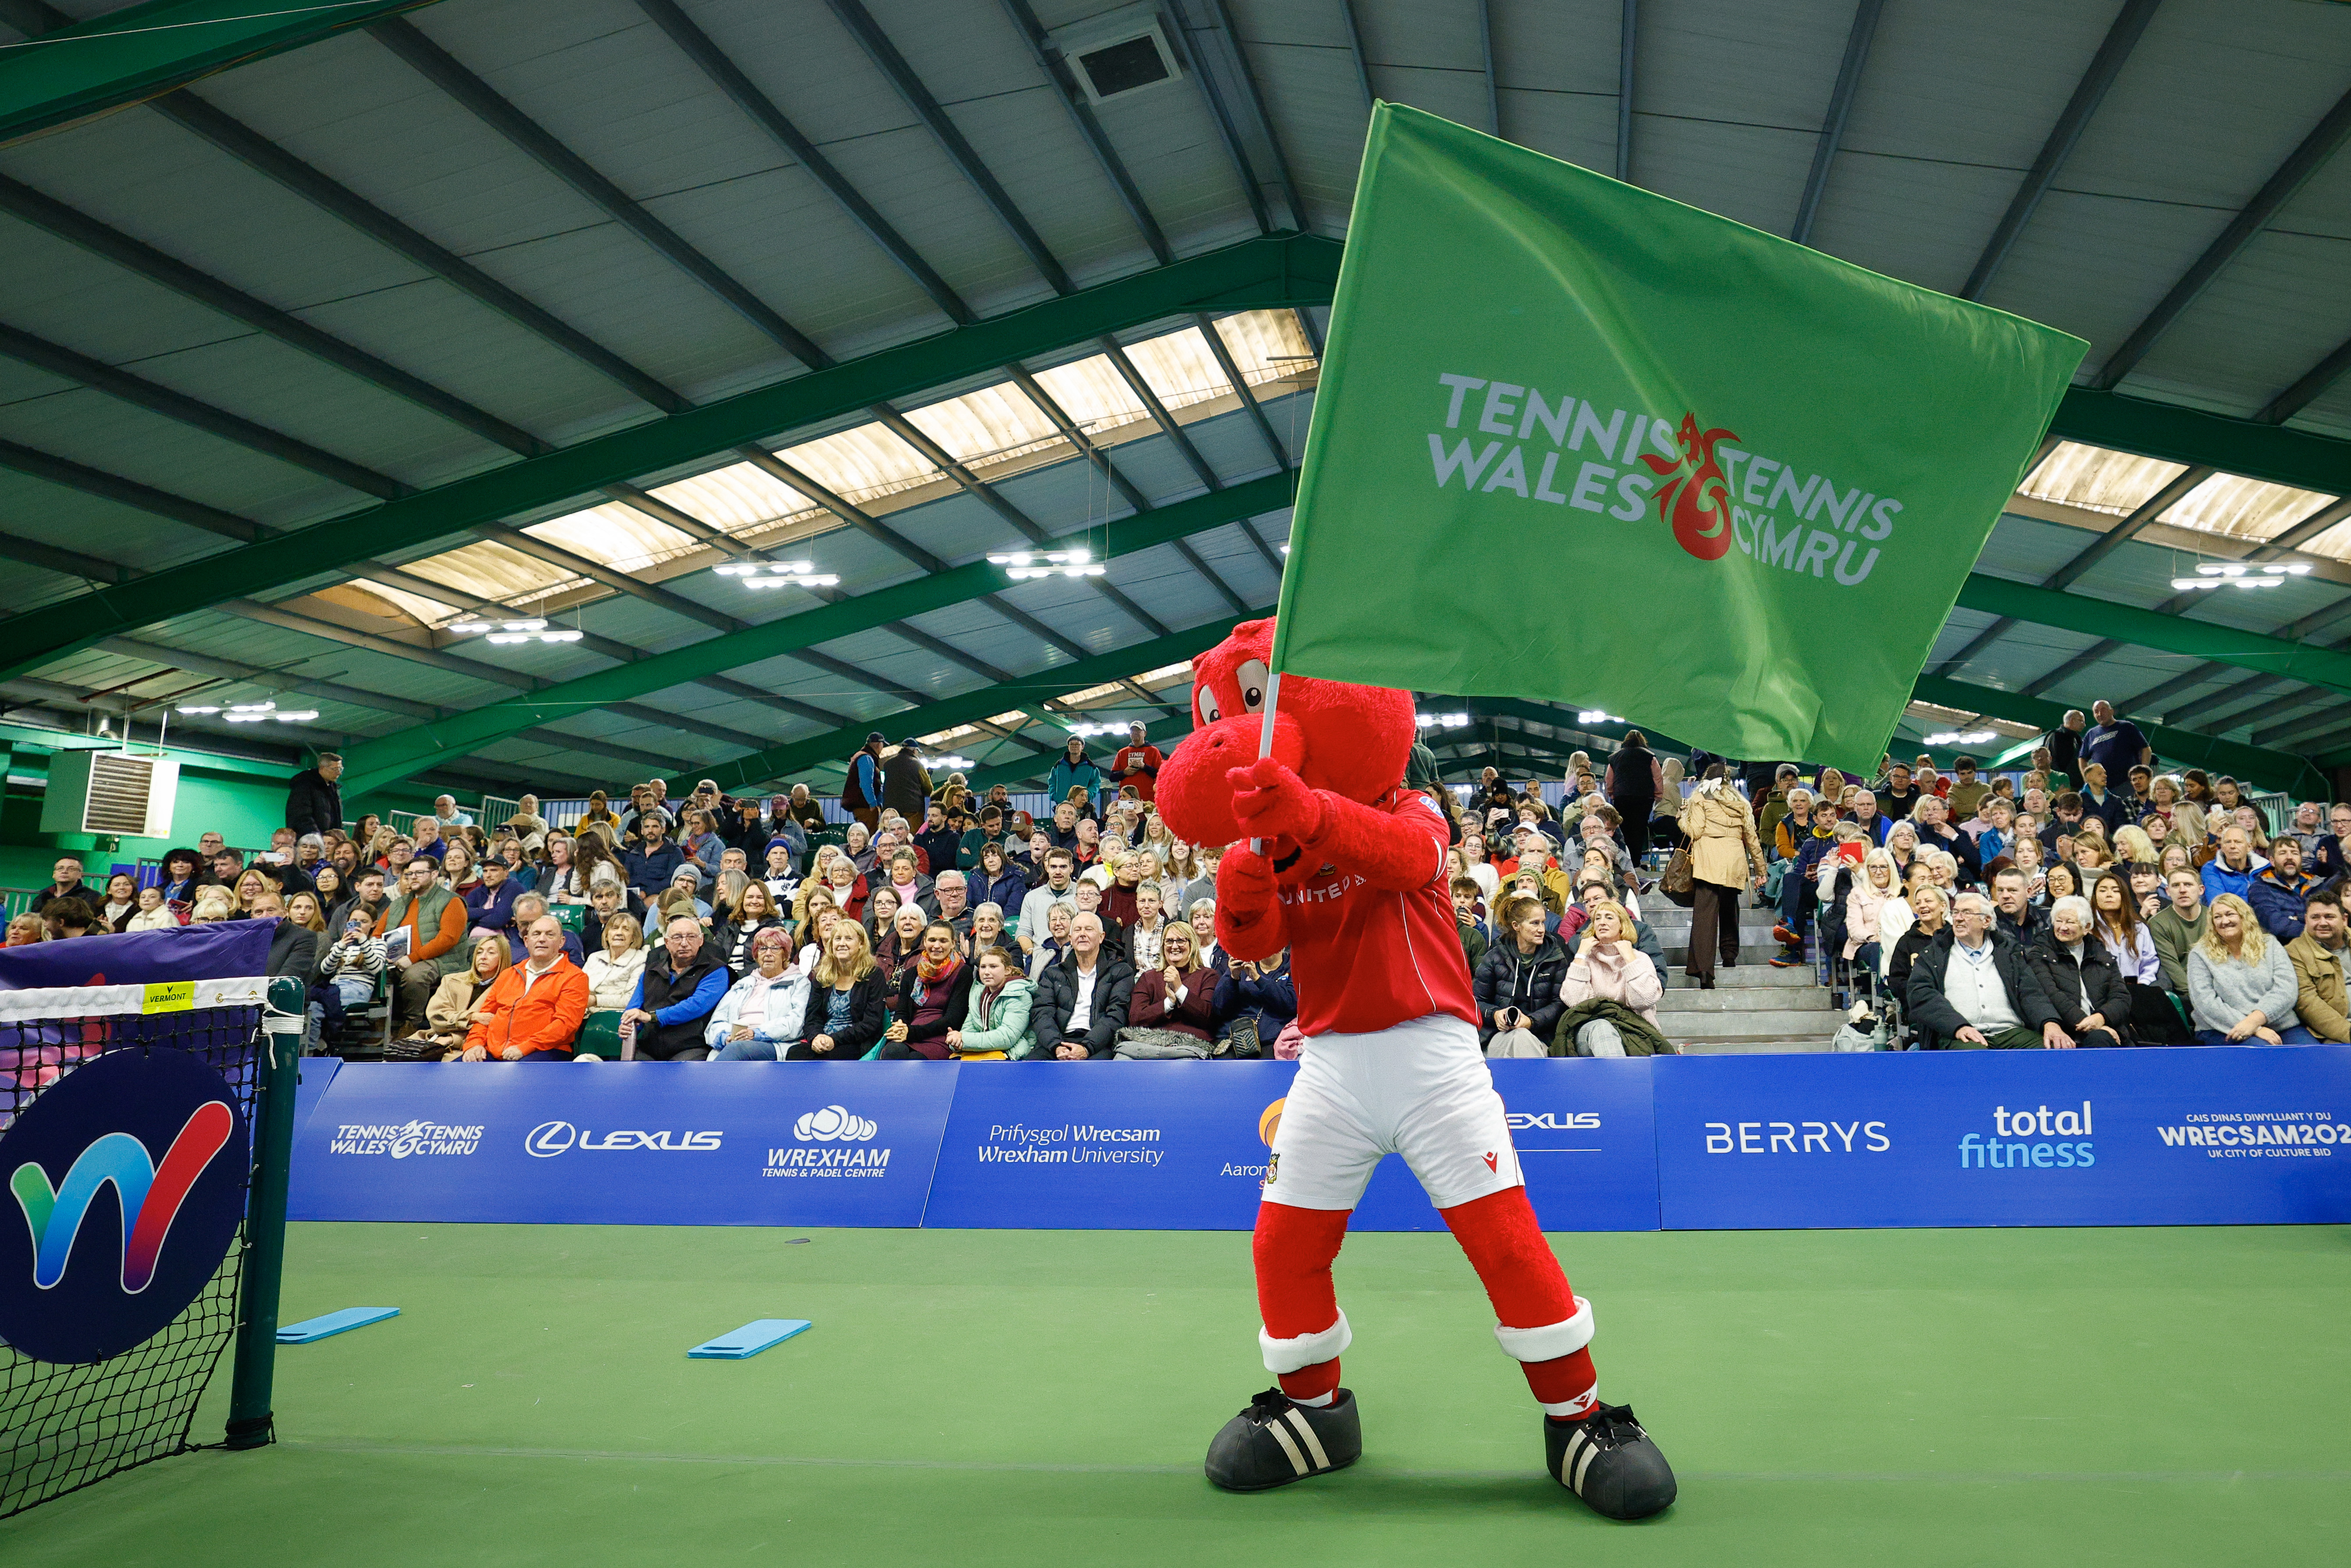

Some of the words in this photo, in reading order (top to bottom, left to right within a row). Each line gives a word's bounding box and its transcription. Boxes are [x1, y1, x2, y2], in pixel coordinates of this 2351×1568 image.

[1439, 372, 1675, 466] TENNIS
[1427, 433, 1654, 522] WALES
[1718, 445, 1904, 541] TENNIS
[1732, 509, 1881, 586] CYMRU
[1277, 875, 1350, 906] UNITED
[150, 992, 186, 1003] VERMONT
[1504, 1113, 1601, 1129] EXUS
[1993, 1101, 2092, 1136] total
[2186, 1114, 2209, 1122] CAIS
[2211, 1113, 2243, 1122] DINAS
[2244, 1112, 2305, 1121] DIWYLLIANT
[2306, 1112, 2313, 1120] Y
[2315, 1112, 2331, 1120] DU
[337, 1125, 399, 1140] TENNIS
[423, 1125, 485, 1140] TENNIS
[579, 1131, 723, 1150] LEXUS
[989, 1124, 1069, 1145] Prifysgol
[1073, 1125, 1160, 1141] Wrecsam
[1705, 1121, 1890, 1153] BERRYS
[330, 1139, 389, 1154] WALES
[415, 1141, 479, 1155] CYMRU
[978, 1145, 1068, 1163] Wrexham
[1071, 1147, 1164, 1167] University
[1958, 1133, 2095, 1168] fitness
[2208, 1149, 2224, 1158] UK
[2224, 1149, 2247, 1158] CITY
[2249, 1148, 2263, 1157] OF
[2265, 1148, 2312, 1157] CULTURE
[2312, 1148, 2331, 1156] BID
[768, 1148, 891, 1167] WREXHAM
[762, 1168, 798, 1177] TENNIS
[799, 1168, 808, 1177] &
[810, 1168, 842, 1177] PADEL
[844, 1168, 886, 1177] CENTRE
[1220, 1163, 1268, 1176] Aaron
